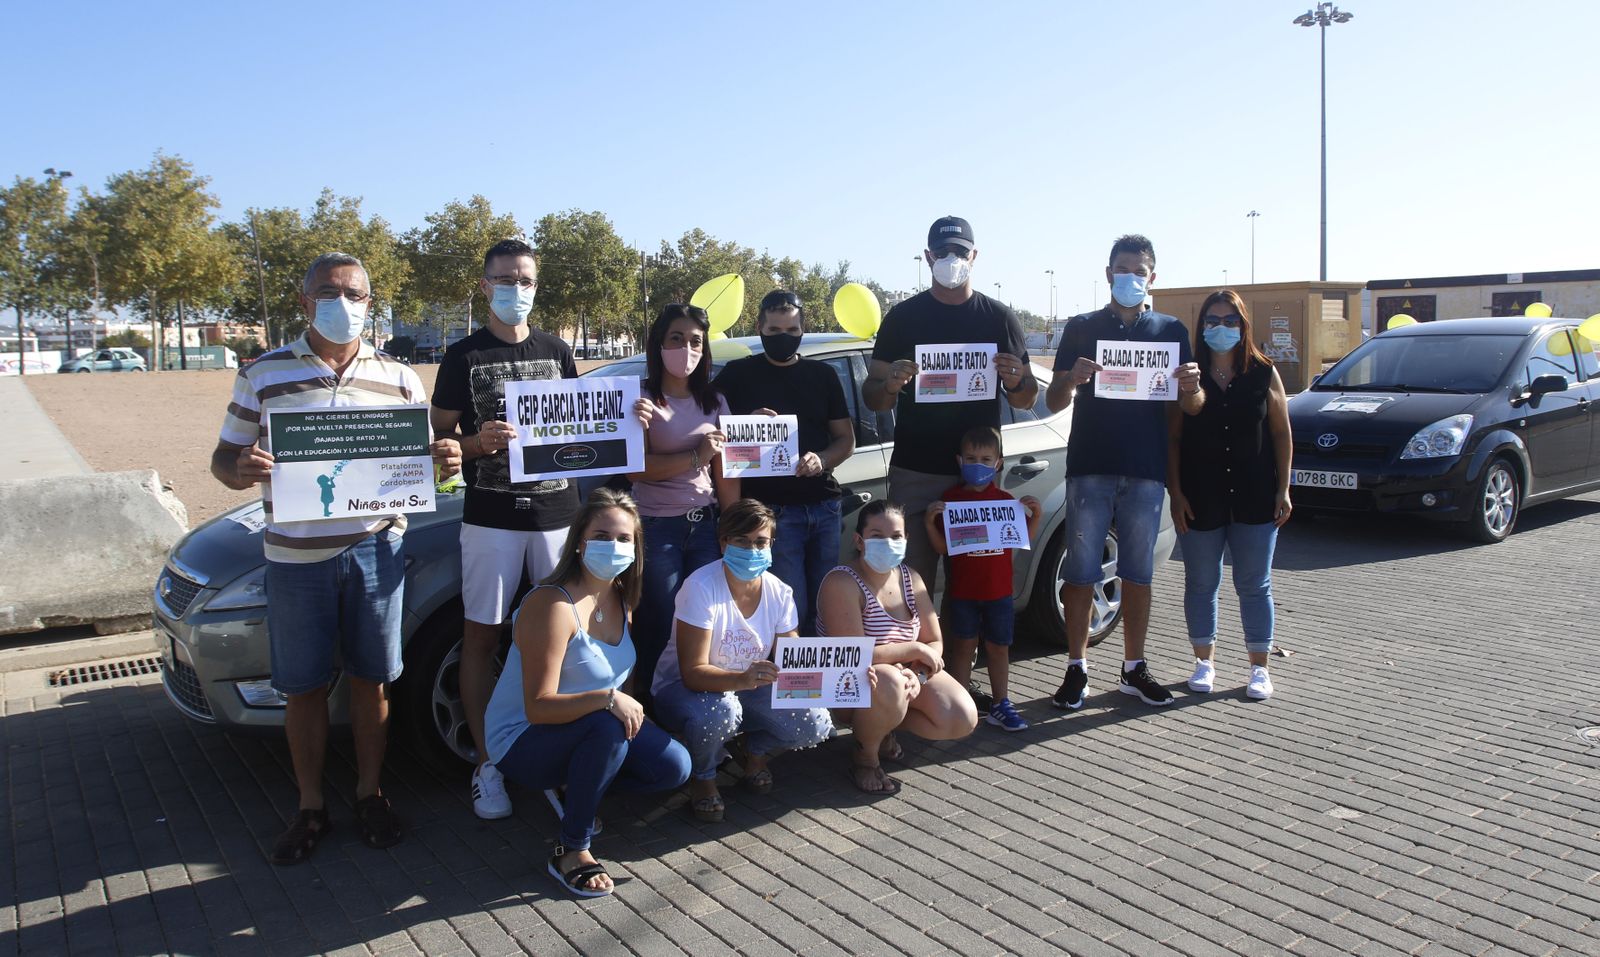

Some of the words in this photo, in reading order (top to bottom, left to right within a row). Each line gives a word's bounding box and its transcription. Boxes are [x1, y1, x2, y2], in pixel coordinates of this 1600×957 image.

[921, 352, 951, 370] BAJADA
[953, 352, 963, 369] DE
[965, 352, 987, 369] RATIO
[1102, 349, 1131, 367] BAJADA
[1134, 350, 1144, 367] DE
[1146, 351, 1169, 368] RATIO
[518, 394, 538, 425] CEIP
[541, 392, 576, 424] GARCIA
[578, 392, 590, 421] DE
[591, 390, 624, 420] LEANIZ
[344, 422, 383, 430] PRESENCIAL
[533, 421, 618, 438] MORILES
[726, 423, 755, 443] BAJADA
[756, 423, 766, 442] DE
[767, 423, 788, 442] RATIO
[380, 463, 423, 471] Plataforma
[380, 479, 424, 487] Cordobesas
[1297, 472, 1327, 485] 0788
[1330, 474, 1354, 487] GKC
[348, 498, 386, 511] Niñ@s
[389, 498, 405, 508] del
[408, 494, 428, 507] Sur
[948, 508, 979, 525] BAJADA
[979, 507, 991, 522] DE
[991, 506, 1015, 522] RATIO
[782, 647, 817, 669] BAJADA
[819, 646, 833, 668] DE
[833, 646, 861, 668] RATIO
